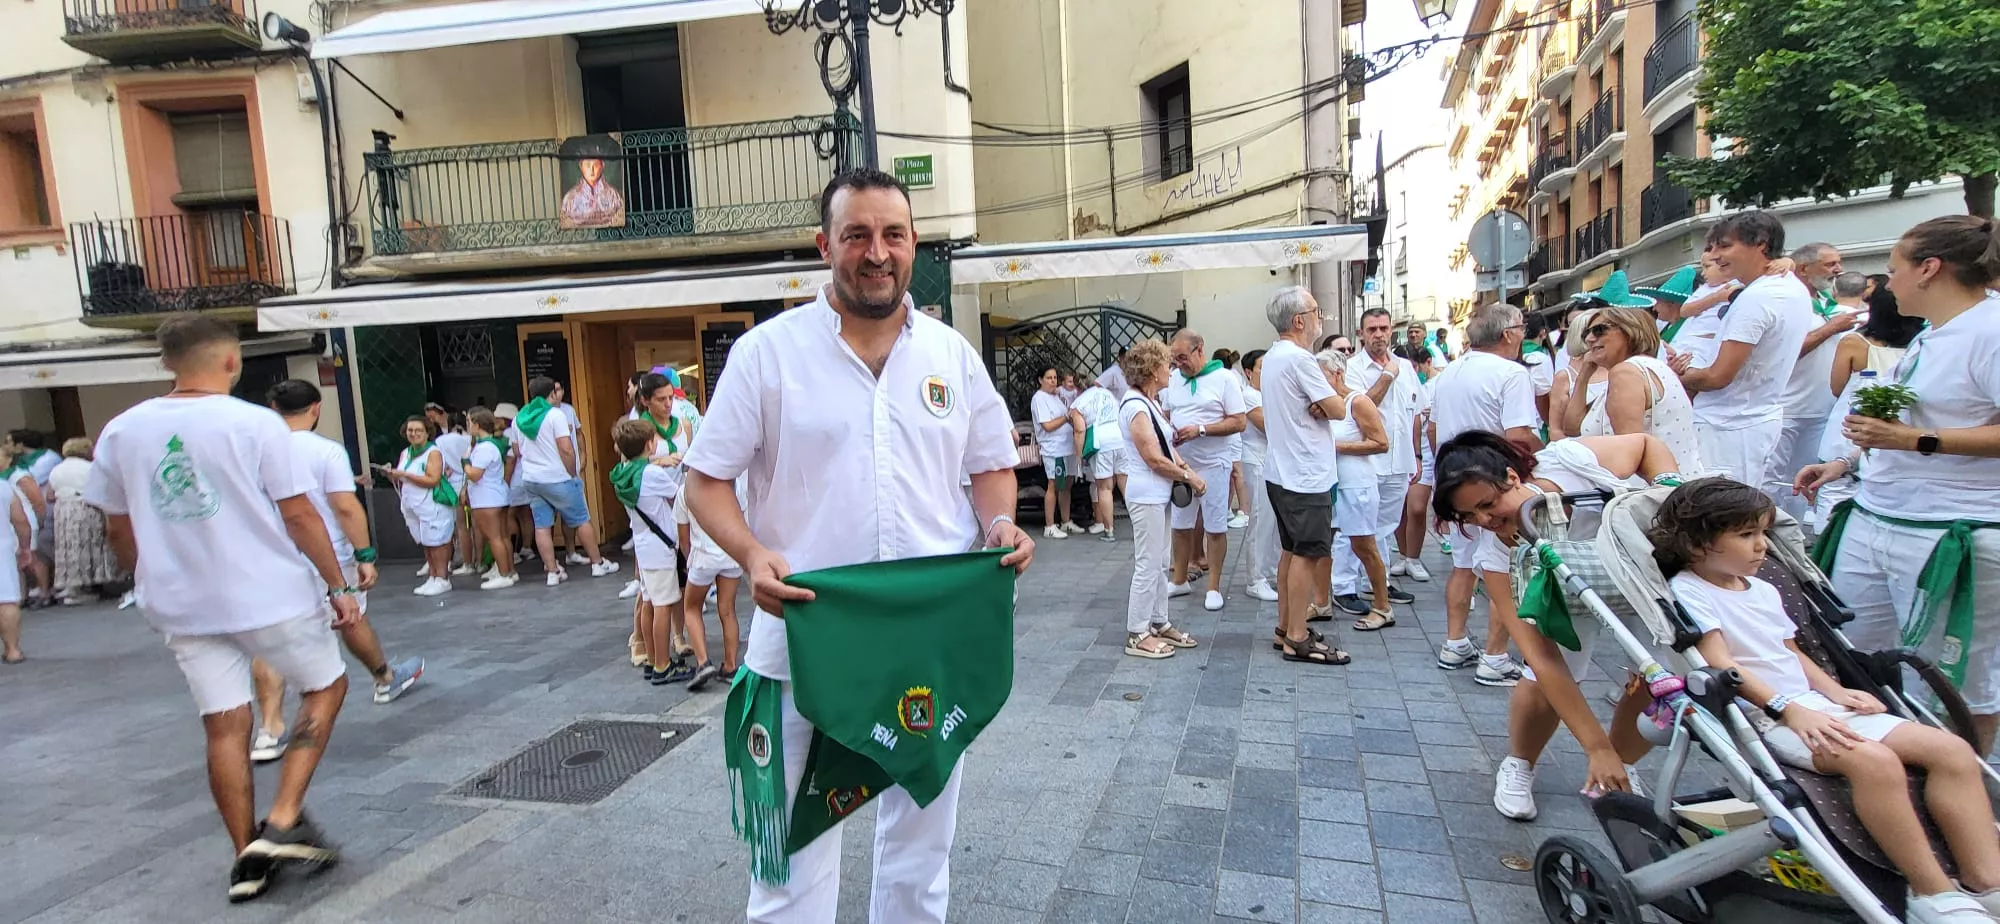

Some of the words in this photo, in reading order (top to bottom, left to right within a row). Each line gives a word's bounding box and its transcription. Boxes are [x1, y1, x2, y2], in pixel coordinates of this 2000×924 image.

[906, 159, 923, 169] Plaza
[909, 171, 932, 184] LORENZO
[870, 722, 898, 751] PEÑA
